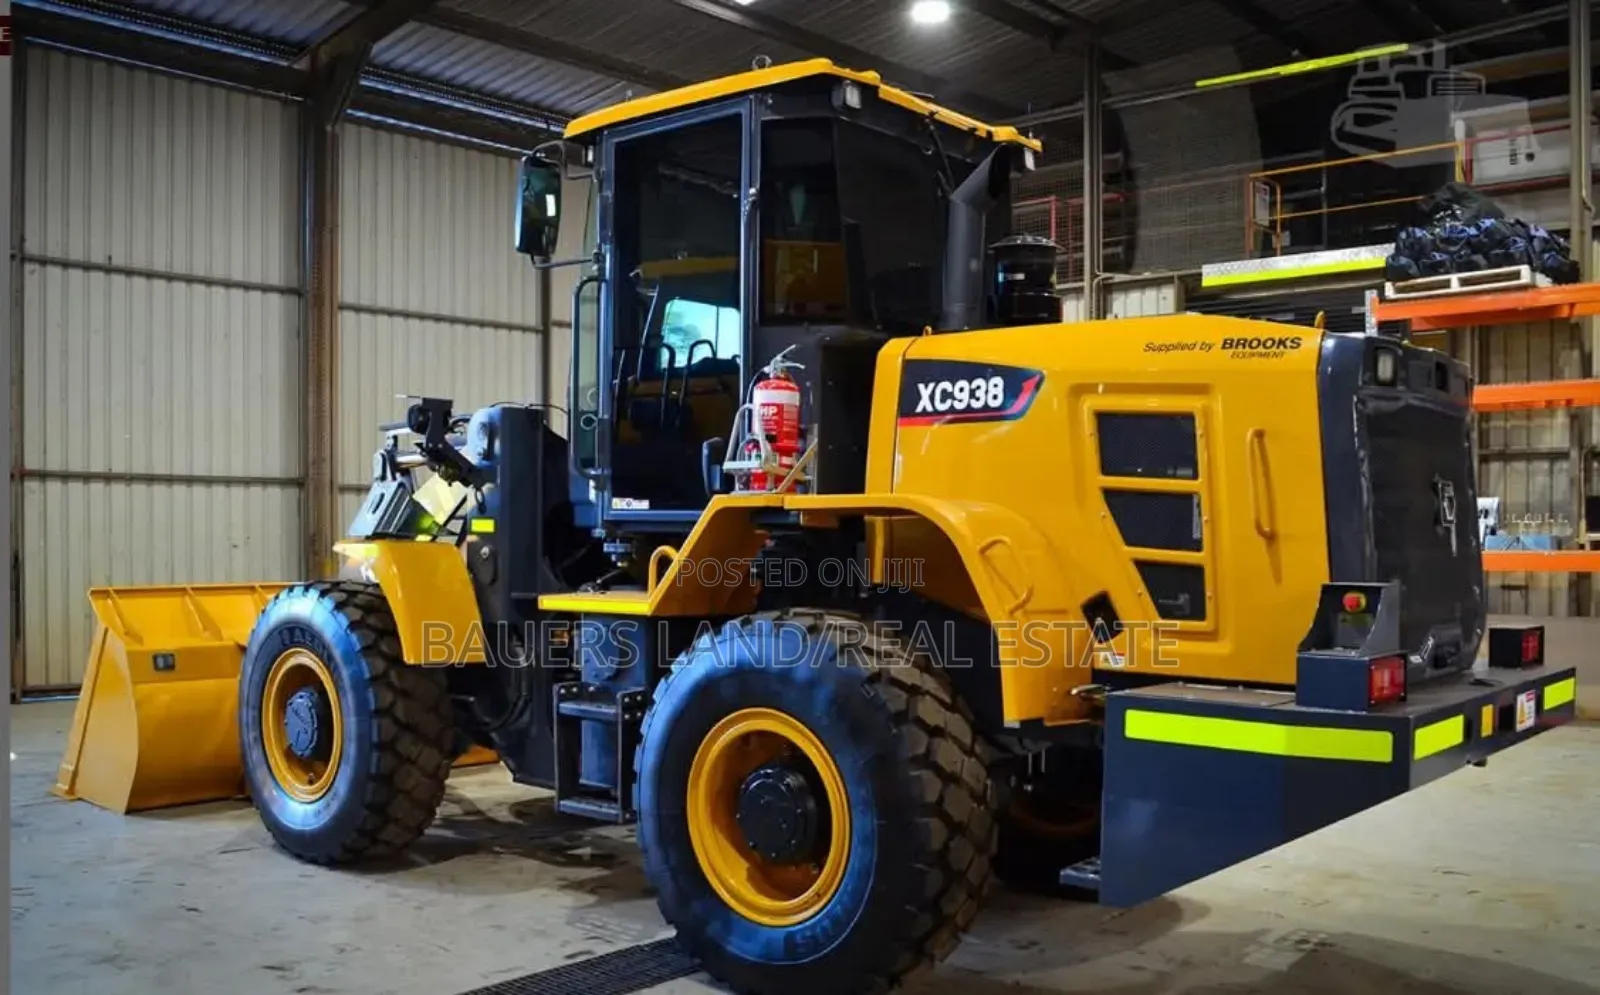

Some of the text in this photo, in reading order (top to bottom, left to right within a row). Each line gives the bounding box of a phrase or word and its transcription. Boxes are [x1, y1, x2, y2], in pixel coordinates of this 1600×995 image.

[1143, 336, 1303, 354] Supplied by BROOKS
[1230, 350, 1287, 360] EQUIPMENT
[915, 375, 1005, 413] XC938
